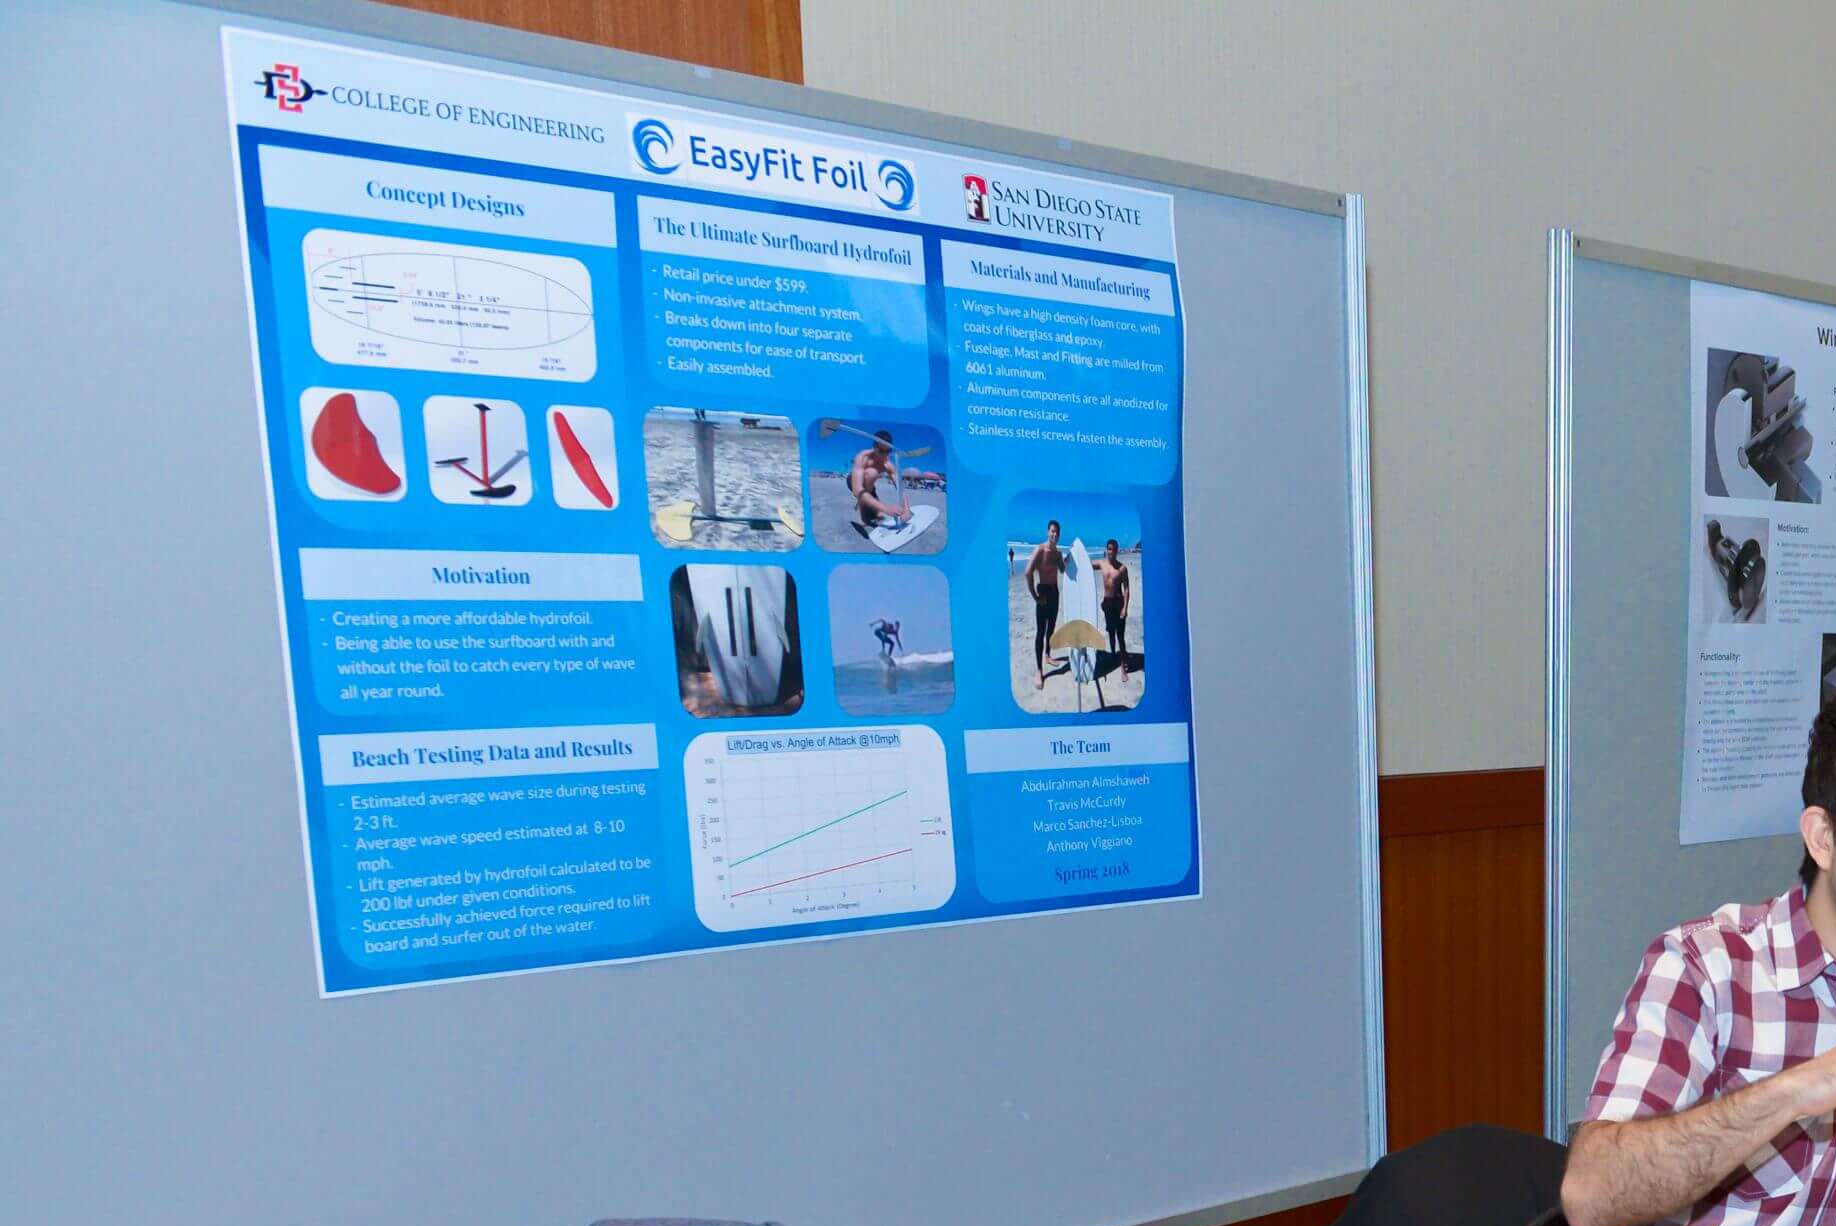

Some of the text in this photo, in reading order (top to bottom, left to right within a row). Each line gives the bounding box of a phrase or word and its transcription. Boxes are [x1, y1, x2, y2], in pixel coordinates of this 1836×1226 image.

[332, 86, 605, 144] COLLEGE OF ENGINEERING
[689, 136, 868, 192] EasyFit Foil
[366, 179, 525, 219] Concept Designs
[992, 181, 1142, 226] SAN DIEGO STATE
[995, 206, 1104, 242] UNIVERSITY
[654, 216, 912, 266] The Ultimate Surfboard Hydrofoil
[663, 264, 808, 293] Retail price under $599.
[971, 260, 1150, 299] Materials and Manufacturing
[664, 288, 863, 322] Non-invasive attachment system.
[962, 300, 1114, 329] Wings high density foam
[665, 311, 852, 342] Breaks down into four separate
[964, 322, 1053, 342] coats fiberglass
[666, 336, 792, 358] components for ease
[668, 356, 773, 378] Easily assembled.
[966, 362, 992, 374] 6061
[1015, 348, 1140, 370] Mast Fitting milled
[967, 383, 1154, 410] Aluminum components anodized
[968, 404, 1016, 417] corrosion
[969, 423, 1106, 444] Stainless steel screws fasten
[432, 567, 530, 585] Motivation
[332, 611, 592, 628] Creating more affordable hydrofoil.
[335, 634, 615, 653] Being able to use the surfboard with and
[337, 657, 635, 675] without the foil to catch every type of wave
[340, 683, 443, 701] all year round.
[352, 739, 633, 768] Beach Testing Data and Results
[727, 734, 899, 751] Lift/Drag vs. Angle Attack @10mph
[1051, 740, 1111, 754] The Team
[351, 781, 646, 810] Estimated average wave size during testing
[1021, 779, 1089, 793] Abdulrahman
[1048, 796, 1126, 811] Travis McCurdy
[353, 816, 380, 831] 2-3
[1034, 820, 1065, 832] Marco
[355, 821, 625, 852] Average wave speed estimated at 8-10
[1047, 837, 1132, 852] Anthony Viggiano
[357, 857, 394, 872] mph.
[359, 857, 651, 893] Lift generated by hydrofoil calculated be
[1055, 862, 1130, 884] Spring 2018
[361, 884, 576, 913] 200 lbf under given conditions.
[362, 895, 651, 934] Successfully achieved force required lift
[365, 923, 551, 953] board and surfer out of the
